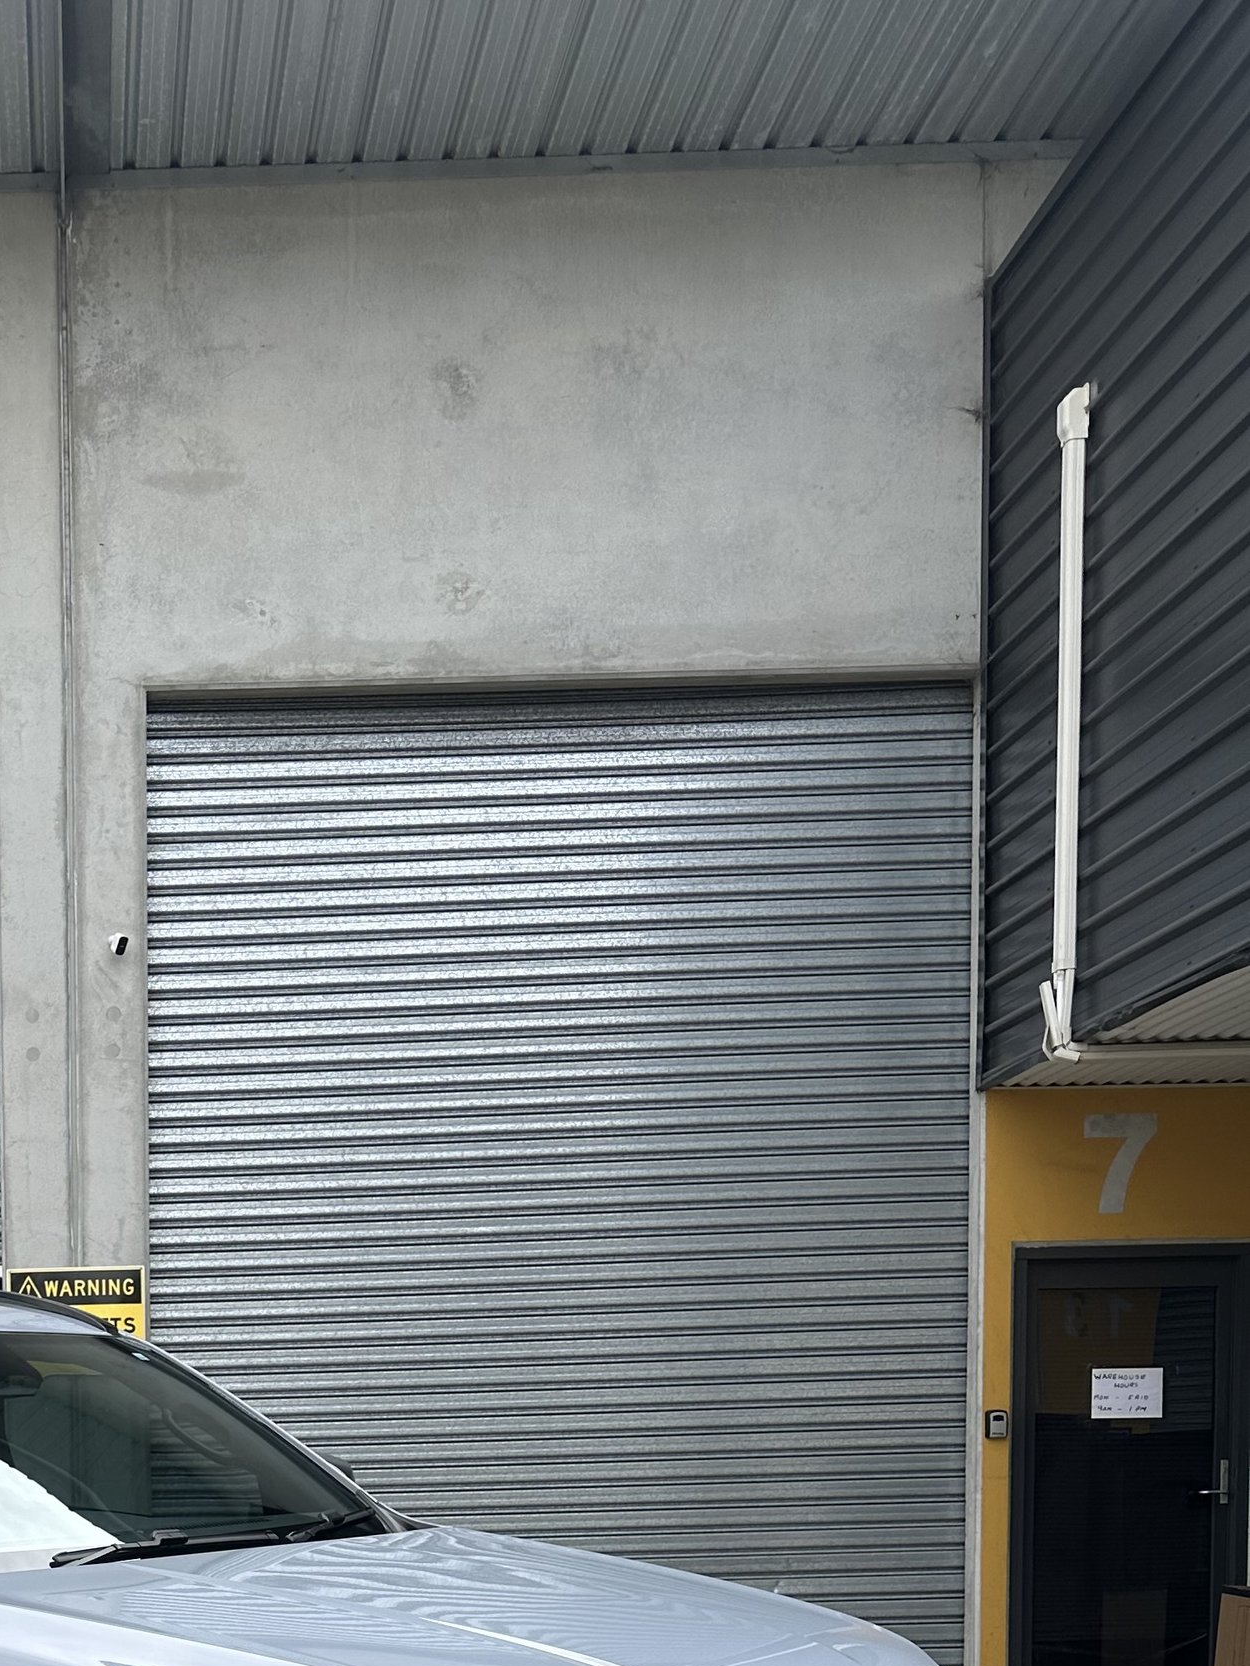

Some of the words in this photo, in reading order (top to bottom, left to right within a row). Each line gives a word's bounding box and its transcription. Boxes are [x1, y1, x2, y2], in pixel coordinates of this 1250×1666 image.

[1084, 1113, 1158, 1214] 7
[44, 1278, 135, 1297] WARNING
[102, 1317, 136, 1333] TS
